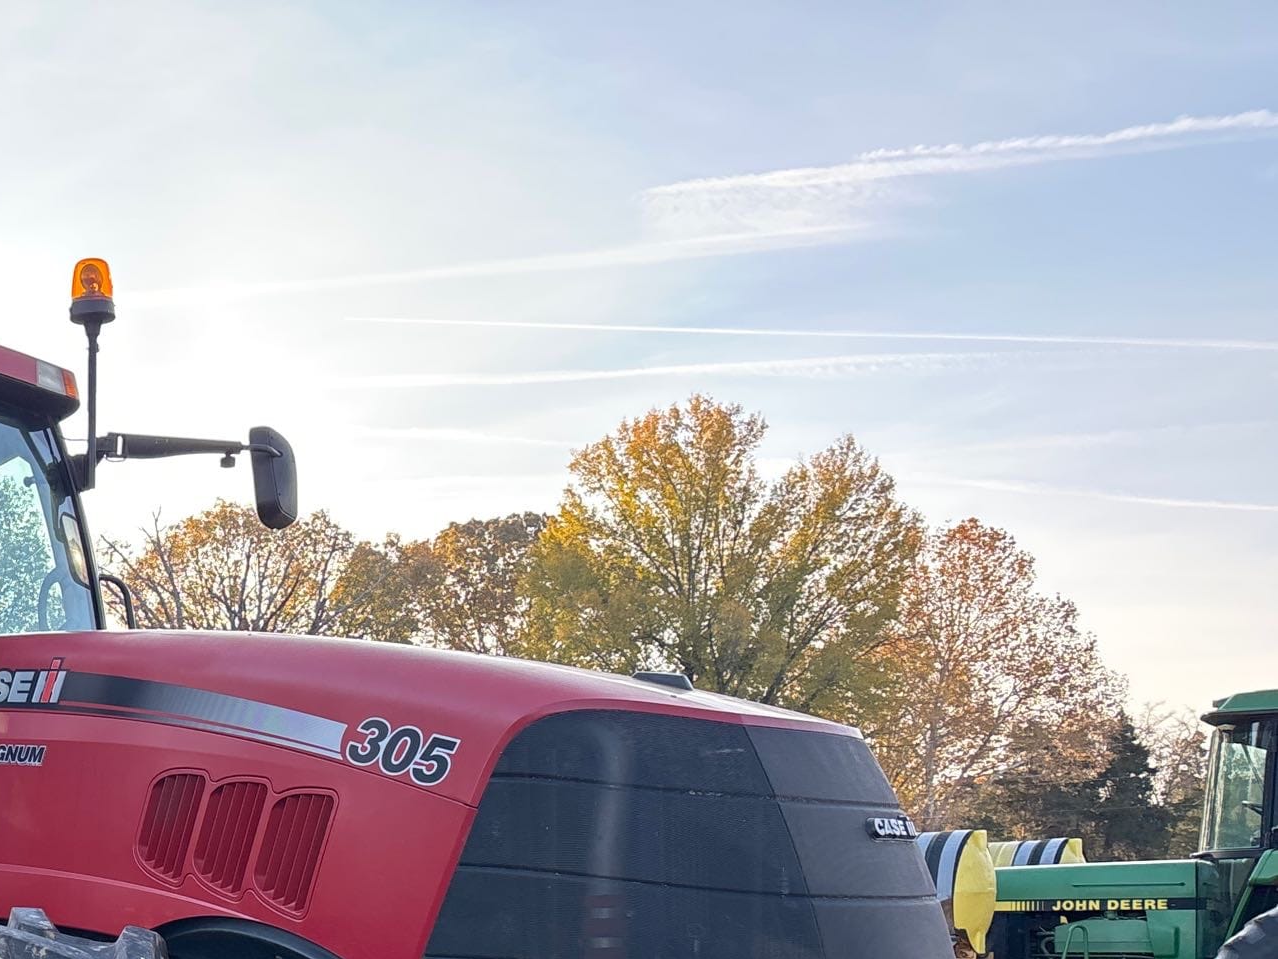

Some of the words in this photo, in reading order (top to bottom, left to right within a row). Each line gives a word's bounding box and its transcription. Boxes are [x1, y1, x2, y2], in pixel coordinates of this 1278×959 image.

[345, 715, 462, 787] 305
[874, 817, 907, 837] CASE
[1051, 899, 1101, 912] JOHN
[1106, 898, 1169, 911] DEERE
